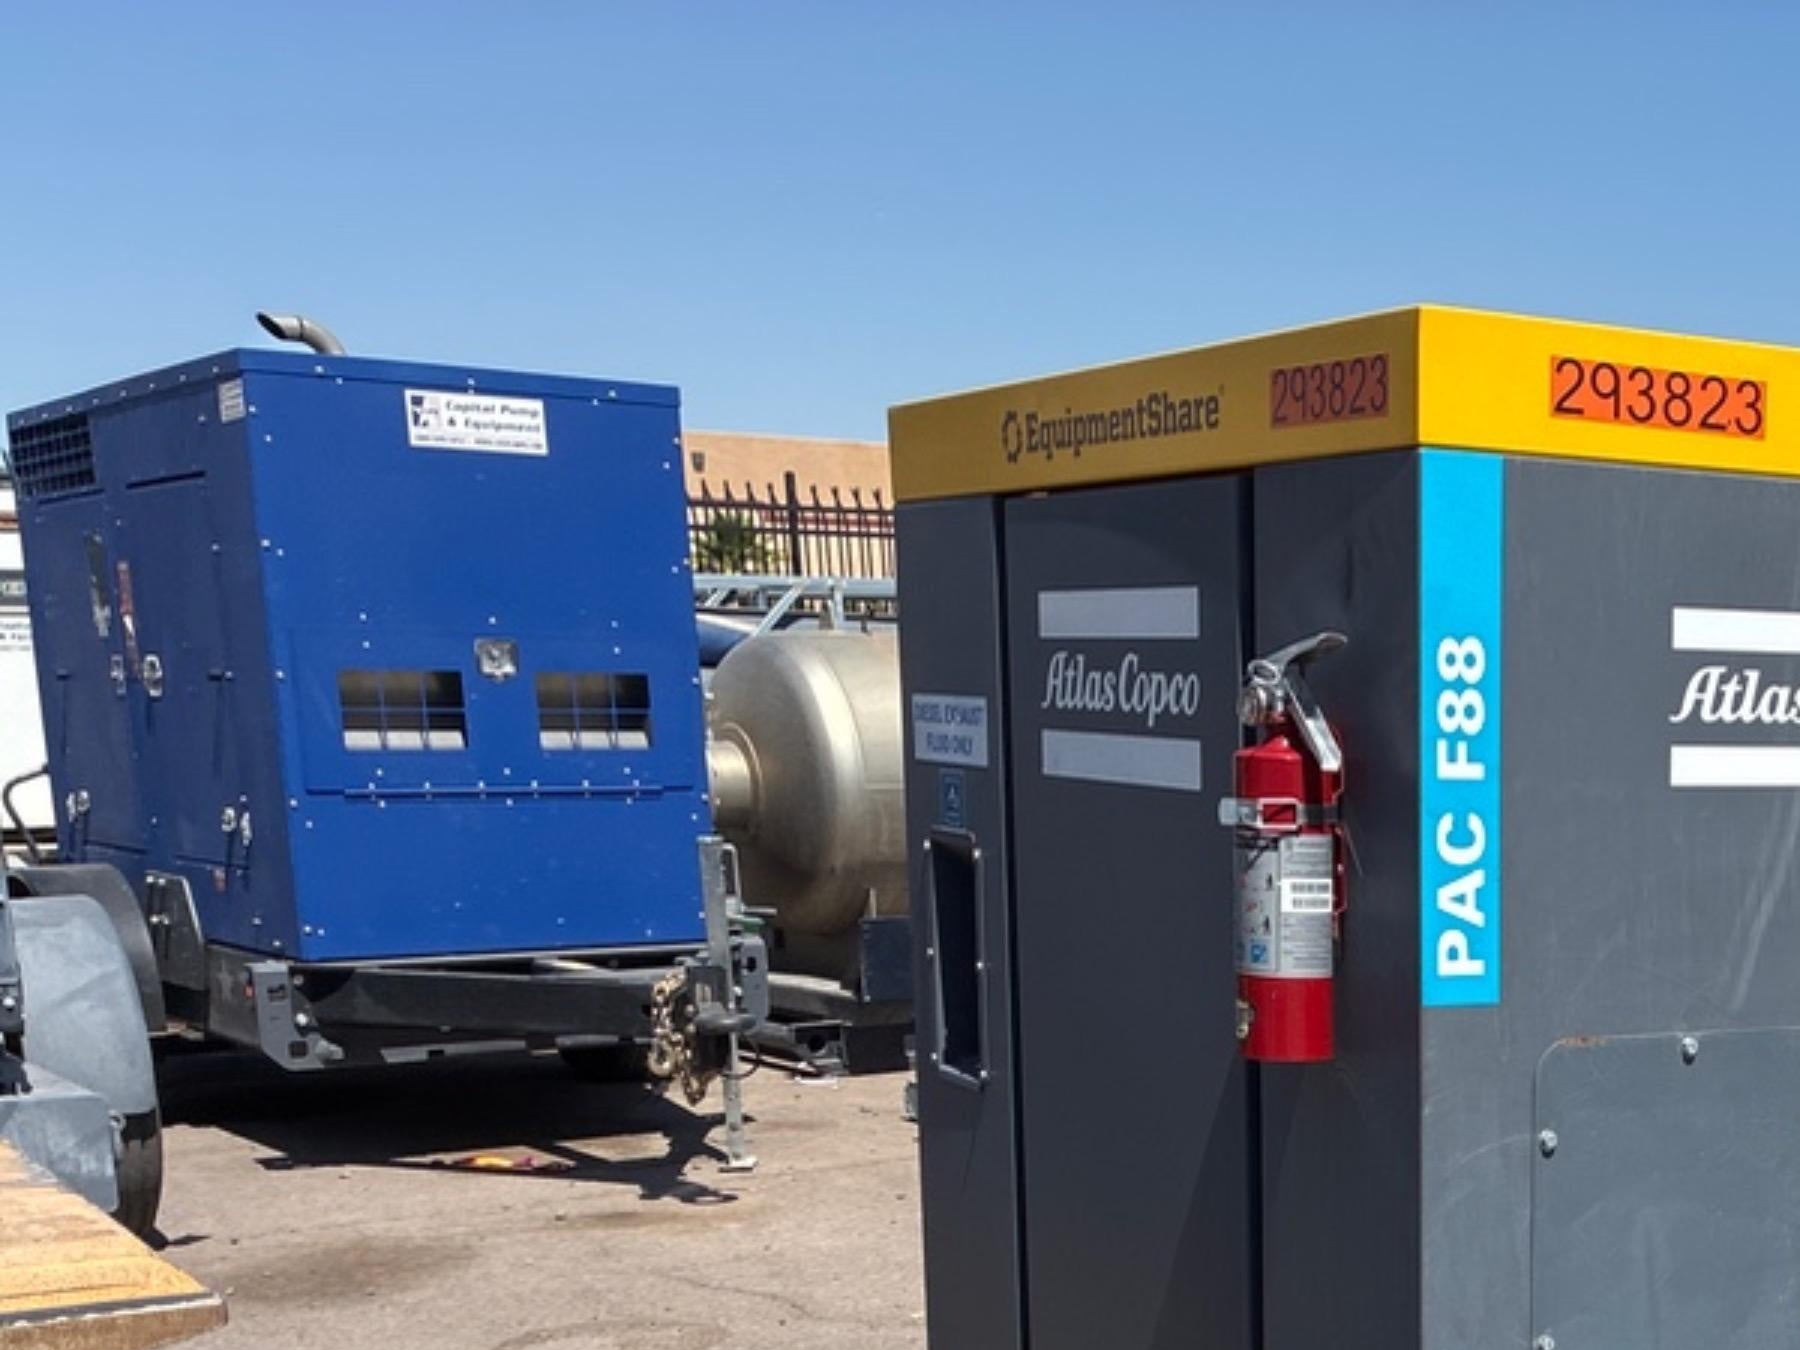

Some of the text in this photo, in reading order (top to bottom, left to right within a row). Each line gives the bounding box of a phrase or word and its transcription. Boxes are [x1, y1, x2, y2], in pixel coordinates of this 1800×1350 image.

[1025, 391, 1219, 460] EquipmentShare
[1273, 353, 1386, 424] 293823
[1554, 357, 1763, 436] 293823
[1041, 651, 1200, 728] Atlas Copco
[1436, 635, 1487, 979] PAC F88
